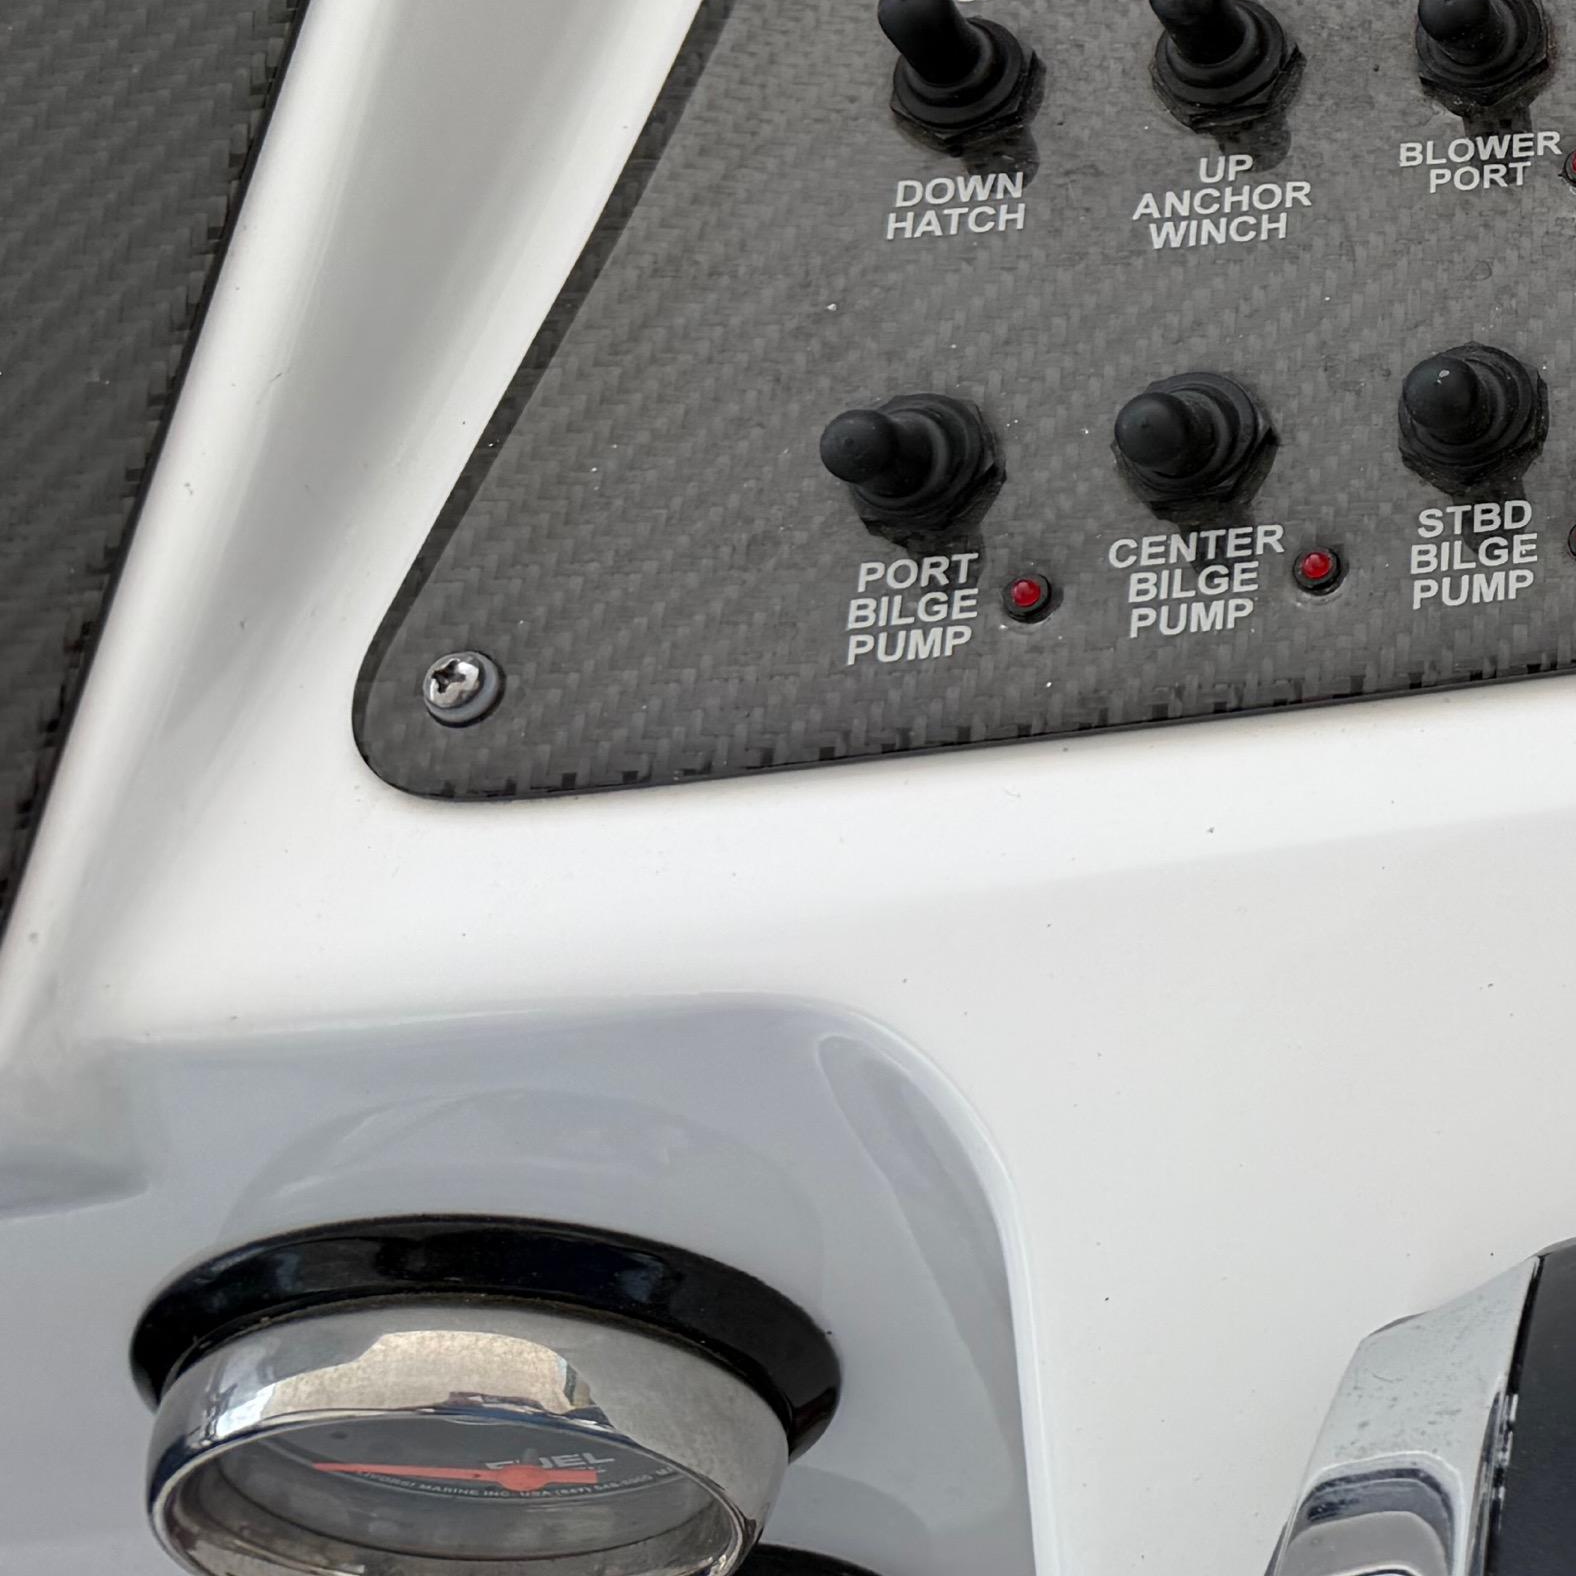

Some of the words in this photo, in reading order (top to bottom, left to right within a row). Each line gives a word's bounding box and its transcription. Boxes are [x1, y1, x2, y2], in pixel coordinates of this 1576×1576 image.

[1198, 154, 1254, 184] UP
[1399, 130, 1562, 169] BLOWER
[894, 171, 1025, 208] DOWN
[1428, 161, 1533, 194] PORT
[1132, 180, 1312, 221] ANCHOR
[885, 202, 1026, 241] HATCH
[1148, 212, 1288, 250] WINCH
[1417, 499, 1533, 538] STBD
[1107, 523, 1285, 570] CENTER
[1409, 533, 1539, 575] BILGE
[856, 552, 979, 593] PORT
[1127, 560, 1260, 603] BILGE
[1411, 569, 1535, 610] PUMP
[846, 587, 978, 631] BILGE
[1129, 597, 1255, 639] PUMP
[845, 623, 973, 666] PUMP
[418, 1483, 480, 1497] MARINE
